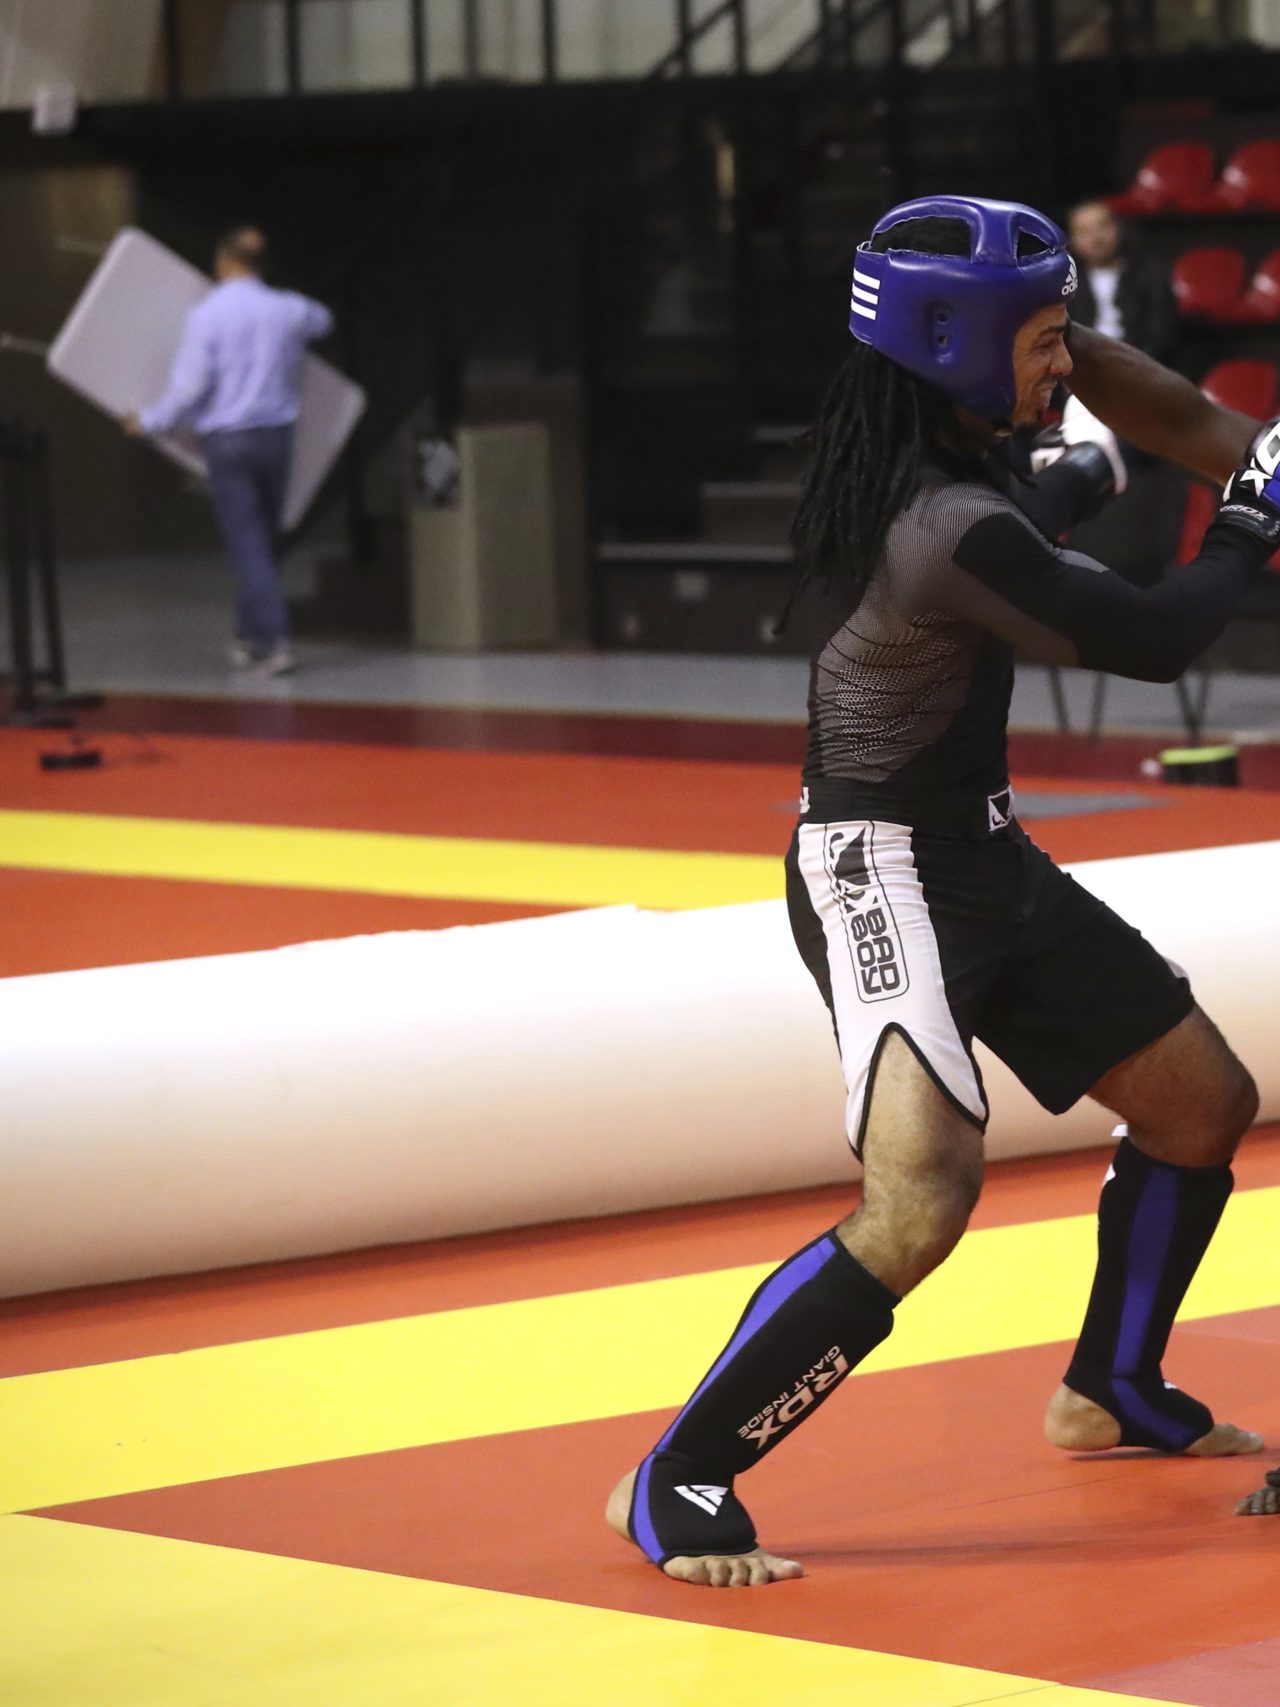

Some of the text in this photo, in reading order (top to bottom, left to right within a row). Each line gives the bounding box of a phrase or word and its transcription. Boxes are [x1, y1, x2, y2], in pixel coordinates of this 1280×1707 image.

[850, 913, 882, 995] BOY
[865, 907, 901, 991] BAD
[737, 1345, 841, 1438] GIANT INSIDE
[745, 1353, 849, 1451] RDX
